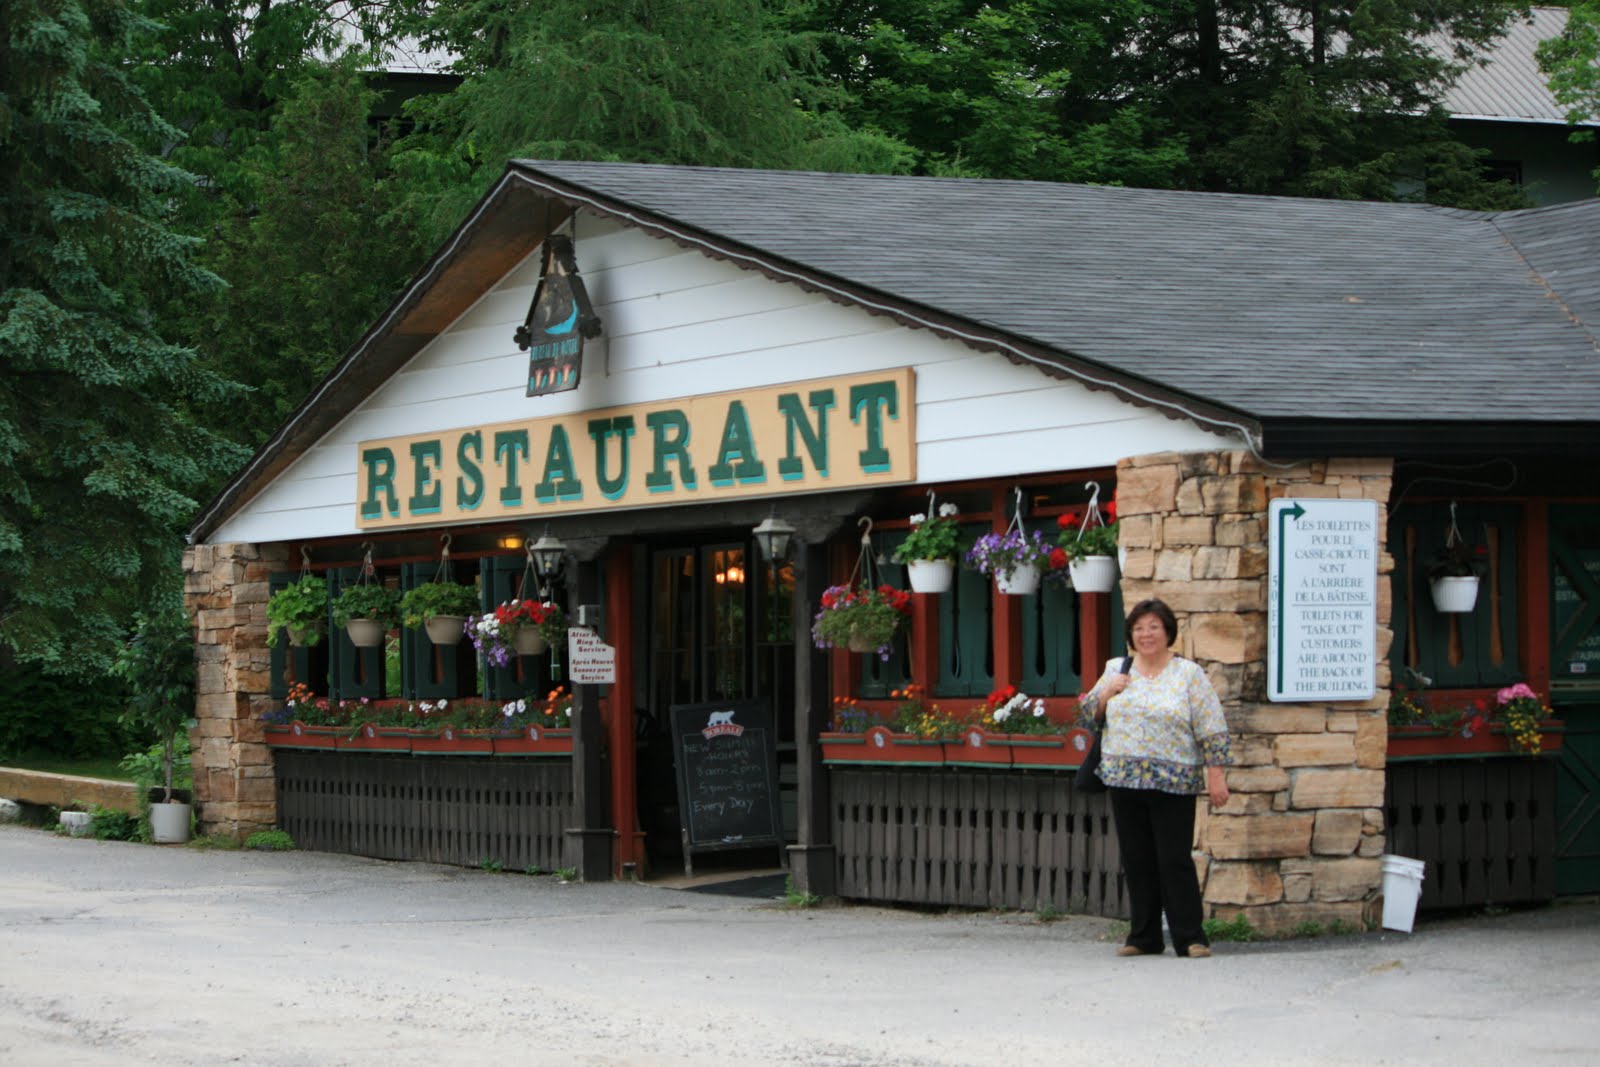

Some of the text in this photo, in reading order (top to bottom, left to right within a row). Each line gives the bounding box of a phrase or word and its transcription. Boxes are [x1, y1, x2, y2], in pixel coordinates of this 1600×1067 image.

[361, 379, 899, 520] RESTAURANT
[1296, 520, 1371, 531] LES TOILETTES
[1312, 535, 1355, 545] POUR LE
[1319, 563, 1346, 574] SONT
[1295, 592, 1309, 602] DE
[1311, 592, 1325, 602] LA
[1300, 610, 1363, 621] TOILETS FOR
[1301, 639, 1362, 649] CUSTOMERS
[1297, 653, 1367, 663] ARE AROUND
[1299, 667, 1364, 678] THE BACK OF
[1294, 682, 1317, 692] THE
[693, 797, 754, 815] Every Day
